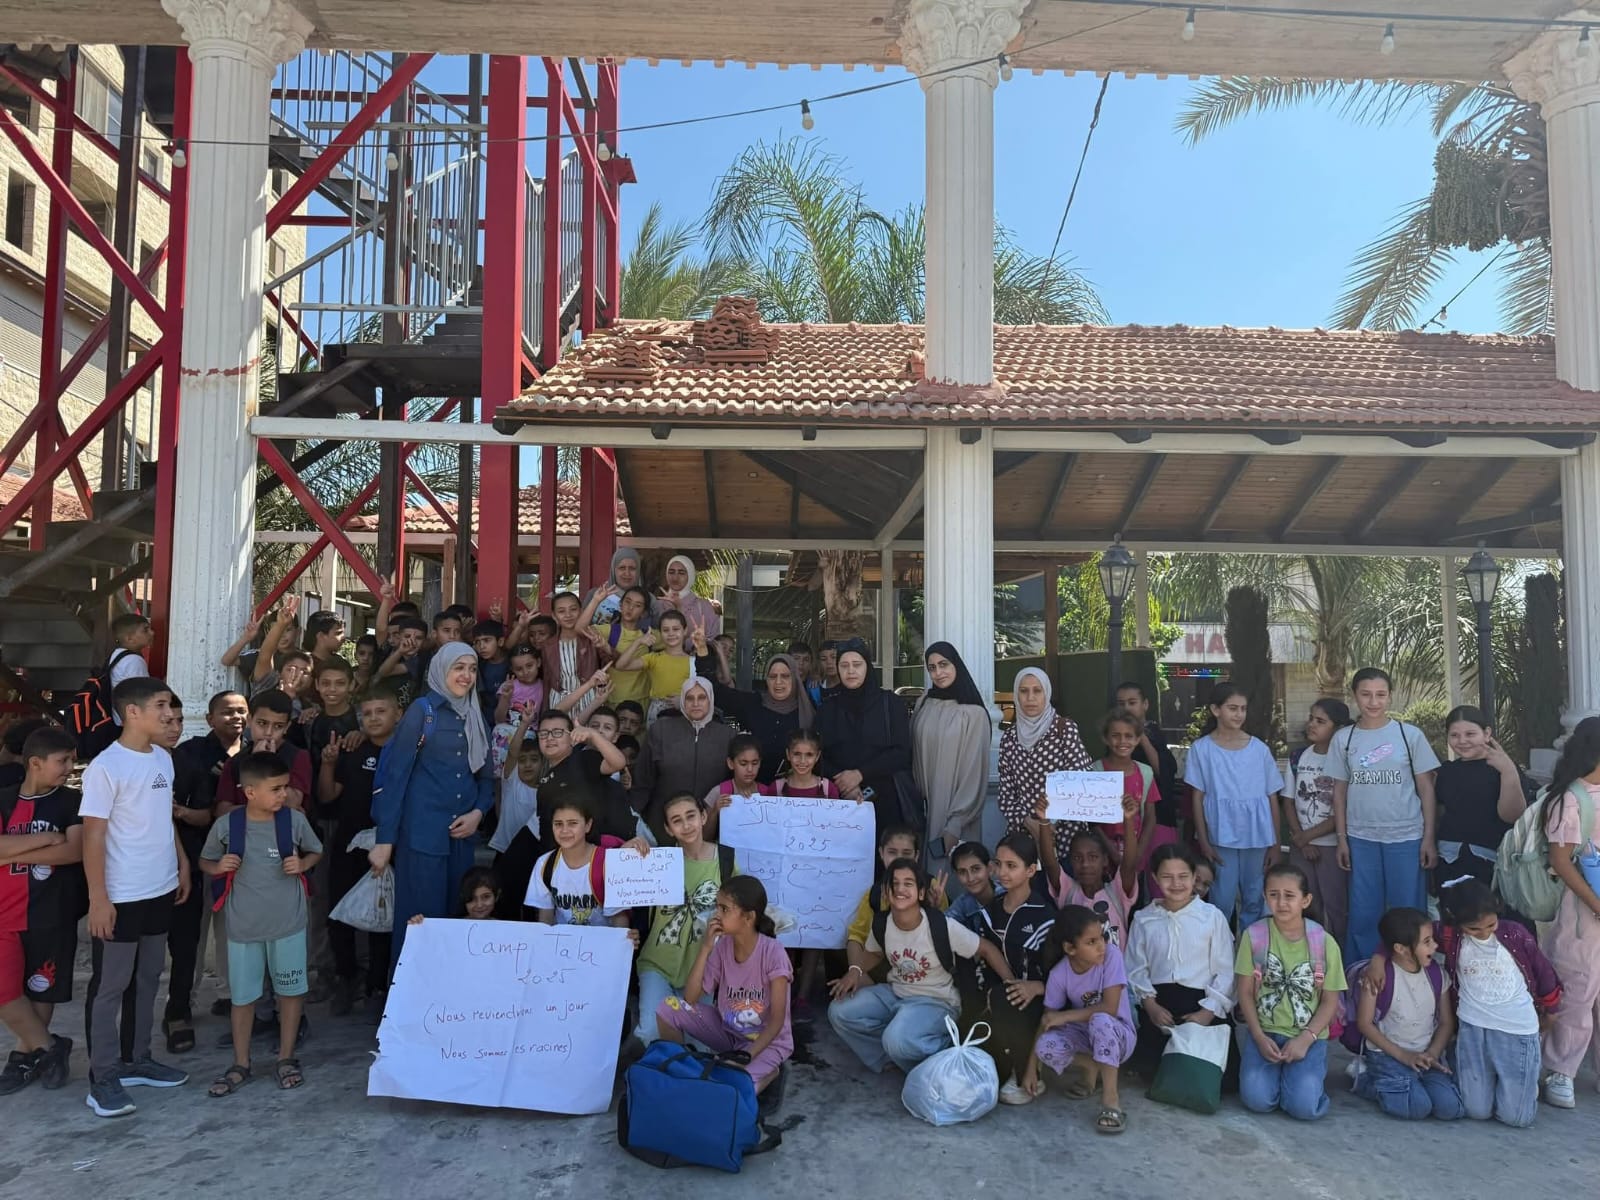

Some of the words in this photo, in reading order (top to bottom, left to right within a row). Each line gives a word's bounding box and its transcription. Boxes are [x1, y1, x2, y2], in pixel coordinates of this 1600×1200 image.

[1350, 769, 1402, 784] REAMING
[785, 836, 832, 851] 2025
[467, 923, 528, 976] Camp
[543, 933, 601, 967] Tala
[517, 968, 576, 985] 2025
[545, 1004, 557, 1013] un
[440, 1038, 468, 1061] Nous
